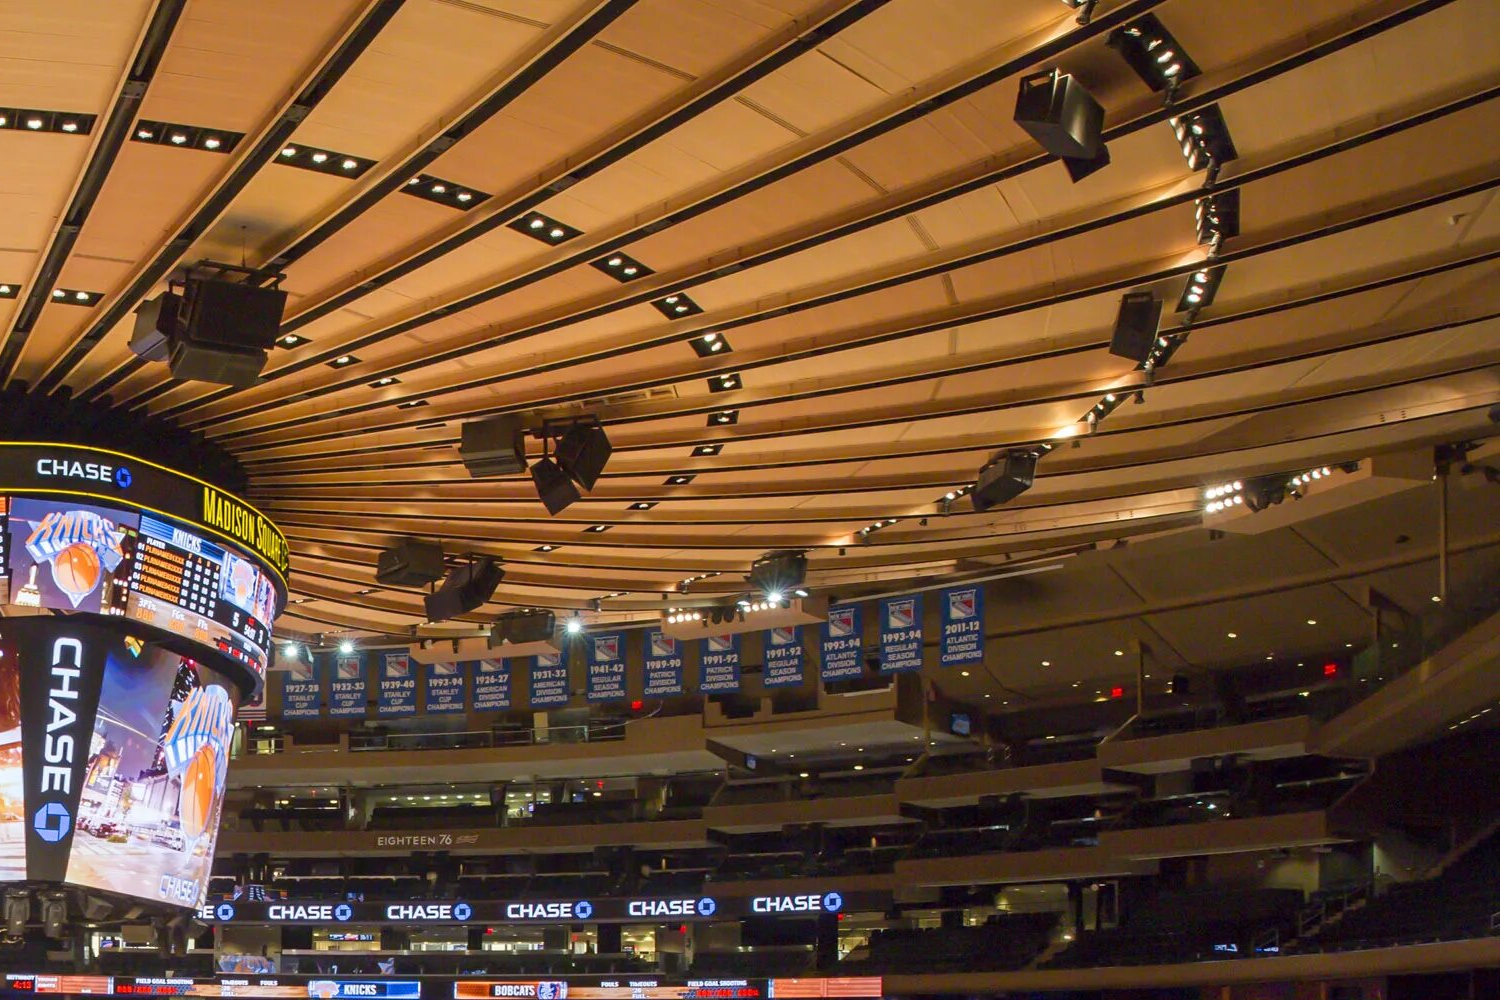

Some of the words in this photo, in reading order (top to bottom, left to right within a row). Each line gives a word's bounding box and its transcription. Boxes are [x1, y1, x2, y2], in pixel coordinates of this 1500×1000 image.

[37, 459, 112, 482] CHASE
[204, 487, 254, 545] MADISON
[25, 512, 123, 556] KNICKS
[147, 538, 165, 549] PLAYER
[173, 528, 201, 552] KNICKS
[233, 612, 239, 627] 5
[945, 621, 979, 634] 2011-12
[883, 630, 921, 643] 1993-94
[947, 634, 978, 644] ATLANTIC
[824, 638, 860, 651] 1993-94
[885, 643, 917, 652] REGULAR
[948, 643, 976, 652] DIVISION
[766, 647, 801, 658] 1991-92
[826, 651, 857, 661] ATLANTIC
[888, 652, 915, 660] SEASON
[942, 651, 982, 662] CHAMPIONS
[704, 655, 738, 665] 1991-92
[768, 659, 798, 667] REGULAR
[828, 660, 855, 669] DIVISION
[881, 659, 922, 670] CHAMPIONS
[533, 670, 566, 679] 1931-32
[590, 664, 624, 674] 1941-42
[822, 667, 861, 678] CHAMPIONS
[381, 680, 414, 689] 1939-40
[765, 674, 802, 684] CHAMPIONS
[286, 684, 319, 692] 1927-28
[332, 682, 364, 690] 1932-33
[644, 686, 681, 694] CHAMPIONS
[701, 682, 739, 690] CHAMPIONS
[532, 695, 567, 703] CHAMPIONS
[588, 690, 625, 698] CHAMPIONS
[41, 637, 82, 794] CHASE
[377, 836, 436, 846] EIGHTEEN
[439, 834, 452, 845] 76
[159, 873, 192, 903] CHASE
[629, 900, 695, 915] CHASE
[753, 896, 821, 912] CHASE
[269, 905, 332, 920] CHASE
[387, 904, 451, 919] CHASE
[507, 903, 572, 918] CHASE
[14, 981, 32, 989] 4:13
[344, 985, 376, 995] KNICKS
[495, 984, 535, 996] BOBCATS
